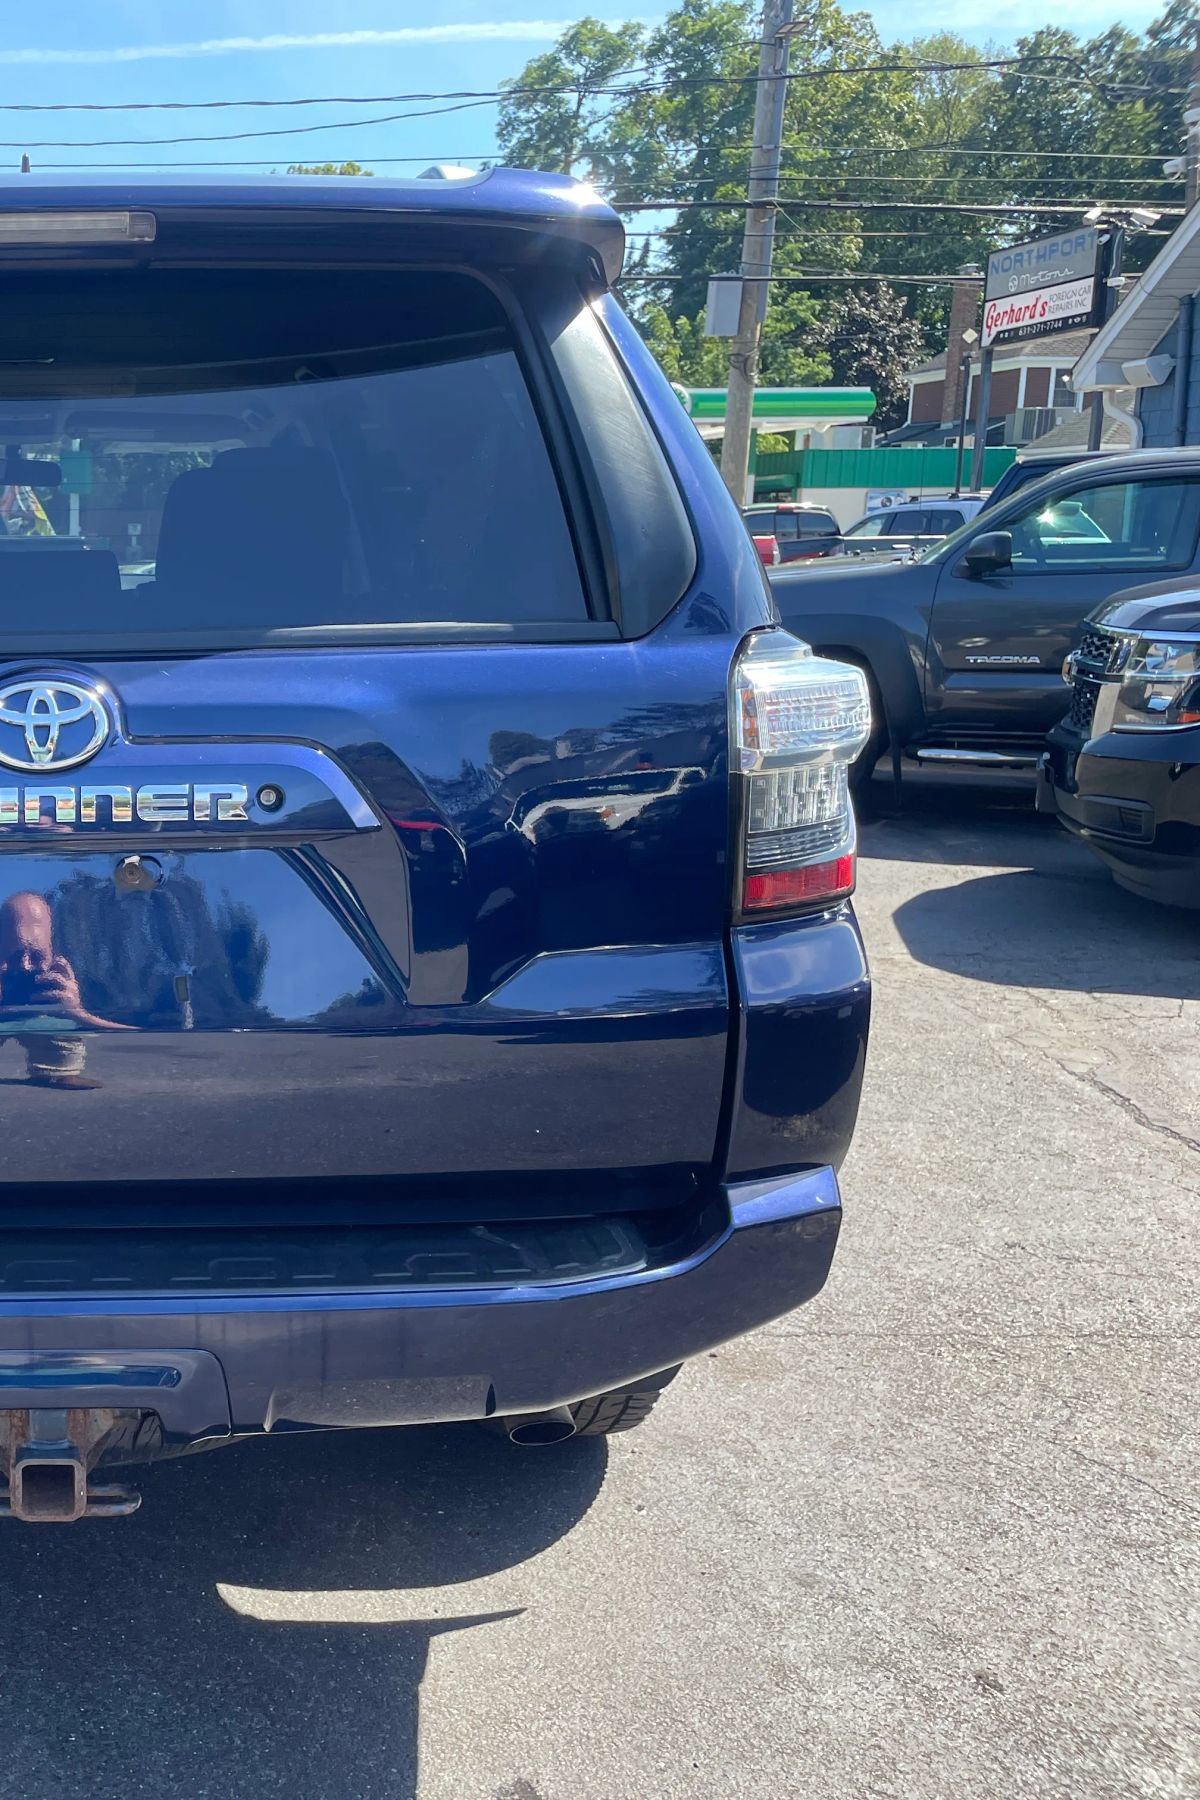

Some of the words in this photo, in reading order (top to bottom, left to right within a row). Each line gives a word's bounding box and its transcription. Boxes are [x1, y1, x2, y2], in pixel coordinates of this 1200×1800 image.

[990, 231, 1098, 275] NORTHPORT
[1019, 268, 1075, 286] Motors
[985, 294, 1048, 338] Gerhard's
[964, 655, 1041, 664] TACOMA
